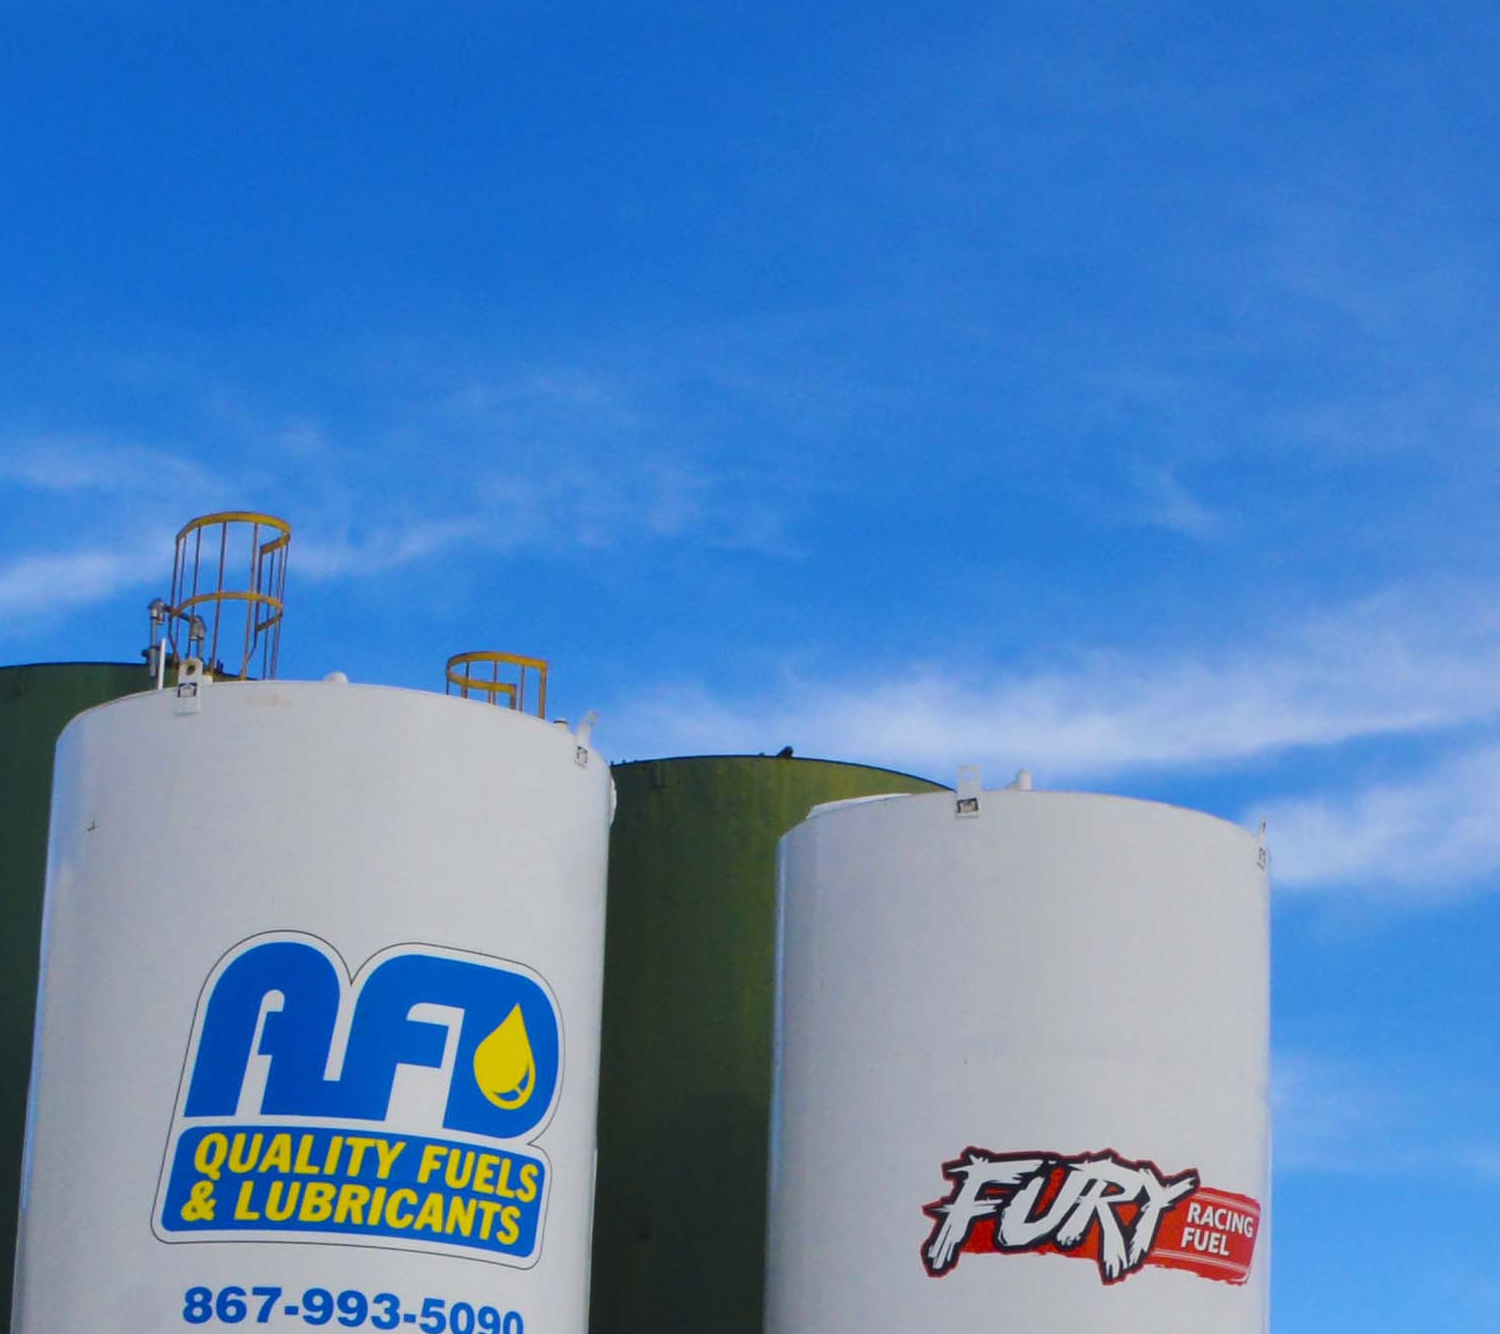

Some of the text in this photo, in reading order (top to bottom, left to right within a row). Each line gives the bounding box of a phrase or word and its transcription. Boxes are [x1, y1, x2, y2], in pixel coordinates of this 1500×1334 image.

[184, 942, 560, 1139] AFD
[194, 1132, 539, 1203] QUALITY FUELS
[180, 1180, 522, 1245] & LUBRICANTS
[927, 1154, 1198, 1278] FURY
[1180, 1227, 1231, 1256] FUEL
[1186, 1202, 1254, 1239] RACING
